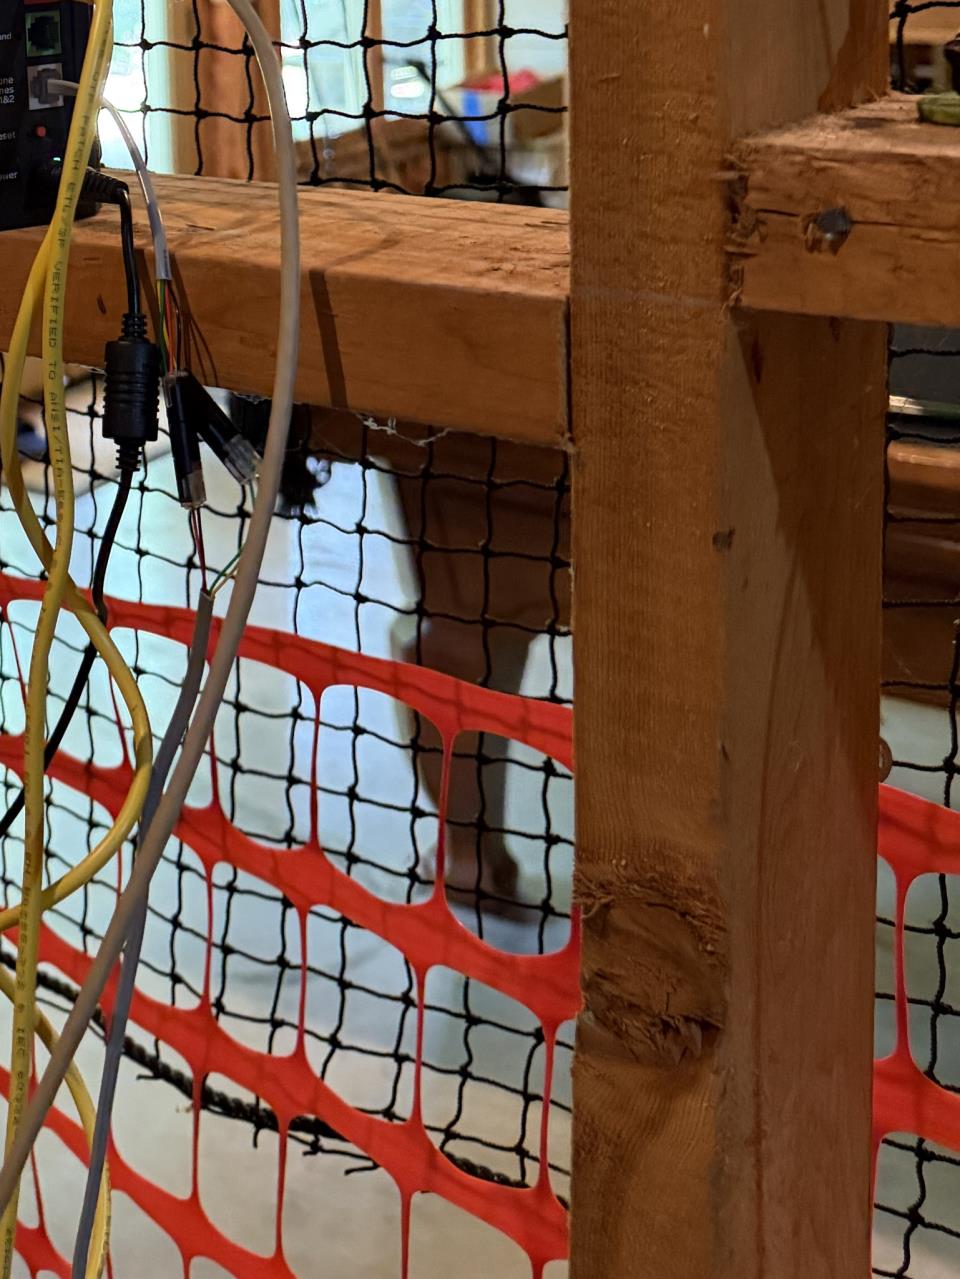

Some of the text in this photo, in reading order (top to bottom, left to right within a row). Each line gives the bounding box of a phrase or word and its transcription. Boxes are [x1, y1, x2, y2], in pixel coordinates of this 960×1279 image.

[0, 95, 15, 104] 1&2
[48, 260, 63, 348] VERIFIED
[48, 361, 57, 381] TO
